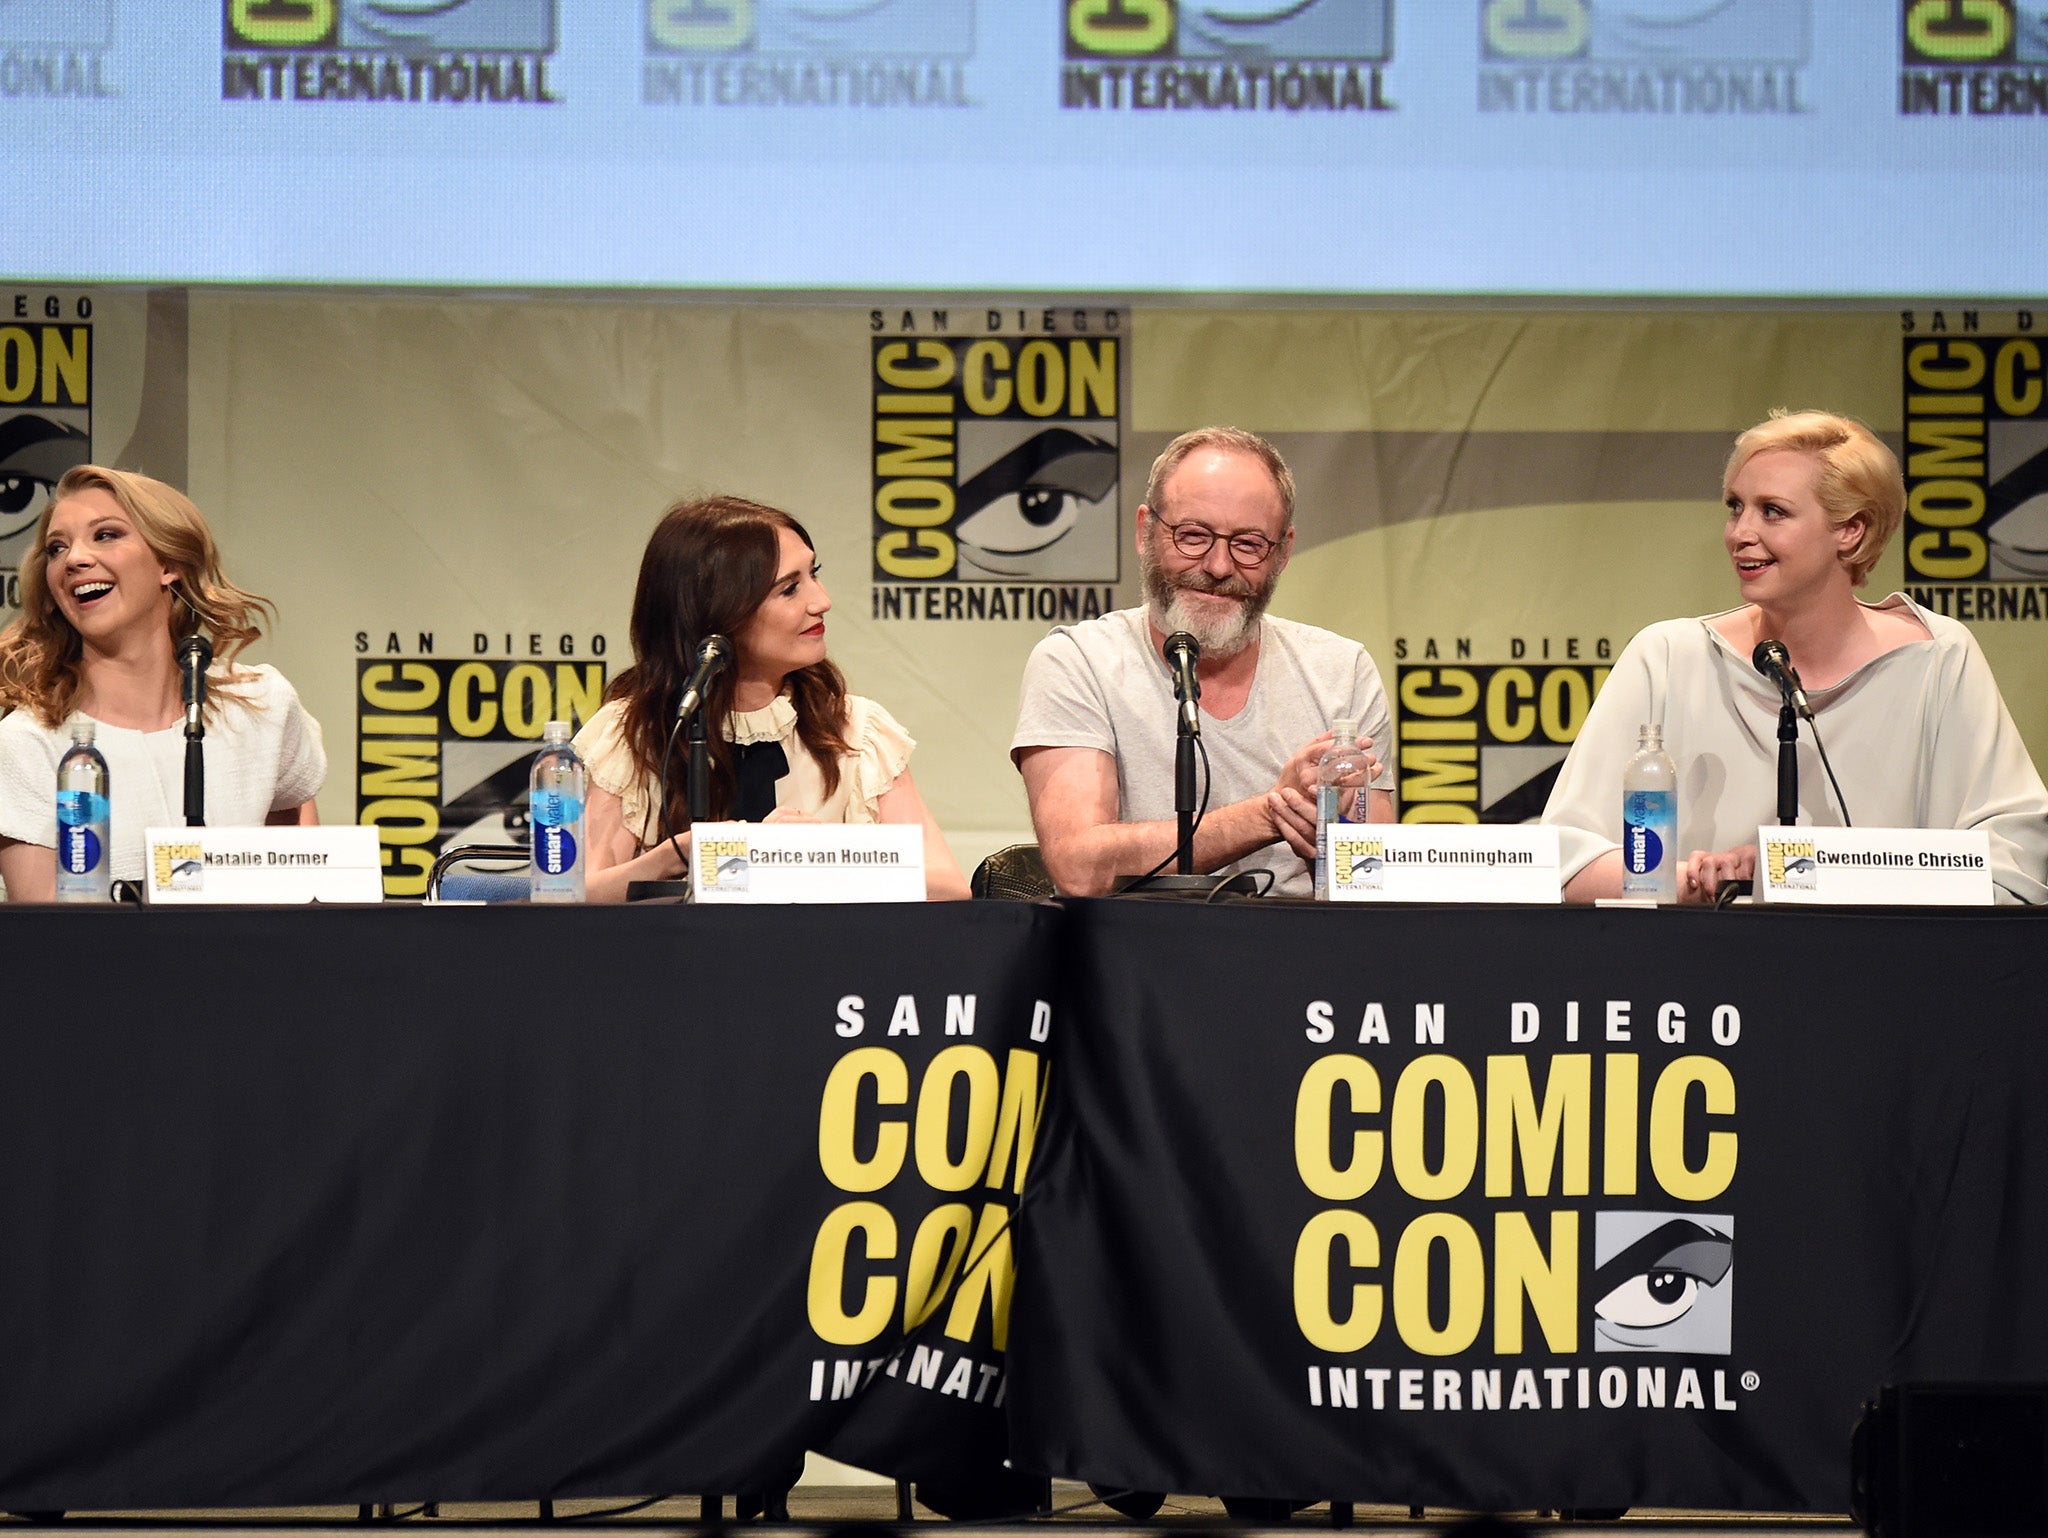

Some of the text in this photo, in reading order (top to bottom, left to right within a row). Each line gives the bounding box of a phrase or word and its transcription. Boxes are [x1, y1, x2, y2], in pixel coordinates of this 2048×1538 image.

[222, 54, 564, 102] INTERNATIONAL
[643, 60, 978, 107] INTERNATIONAL
[1062, 64, 1397, 110] INTERNATIONAL
[1478, 67, 1815, 113] INTERNATIONAL
[870, 309, 1119, 331] SAN DIEGO
[1901, 310, 1978, 331] SAN
[962, 339, 1117, 418] CON
[876, 340, 957, 579] COMIC
[1907, 342, 1988, 579] COMIC
[355, 632, 606, 656] SAN DIEGO
[1395, 638, 1471, 659] SAN
[359, 662, 441, 896] COMIC
[204, 851, 329, 865] Natalie Dormer
[700, 842, 718, 885] COMIC
[716, 842, 747, 856] CON
[750, 849, 900, 864] Carice van Houten
[1335, 841, 1352, 884] COMIC
[1351, 841, 1382, 856] CON
[1385, 849, 1533, 866] Liam Cunningham
[1767, 843, 1785, 883] COMIC
[1783, 843, 1814, 857] CON
[1816, 850, 1984, 868] Gwendoline Christie
[835, 994, 977, 1038] SAN
[1305, 1000, 1741, 1046] SAN DIEGO
[1294, 1052, 1738, 1201] COMIC
[1293, 1208, 1579, 1356] CON
